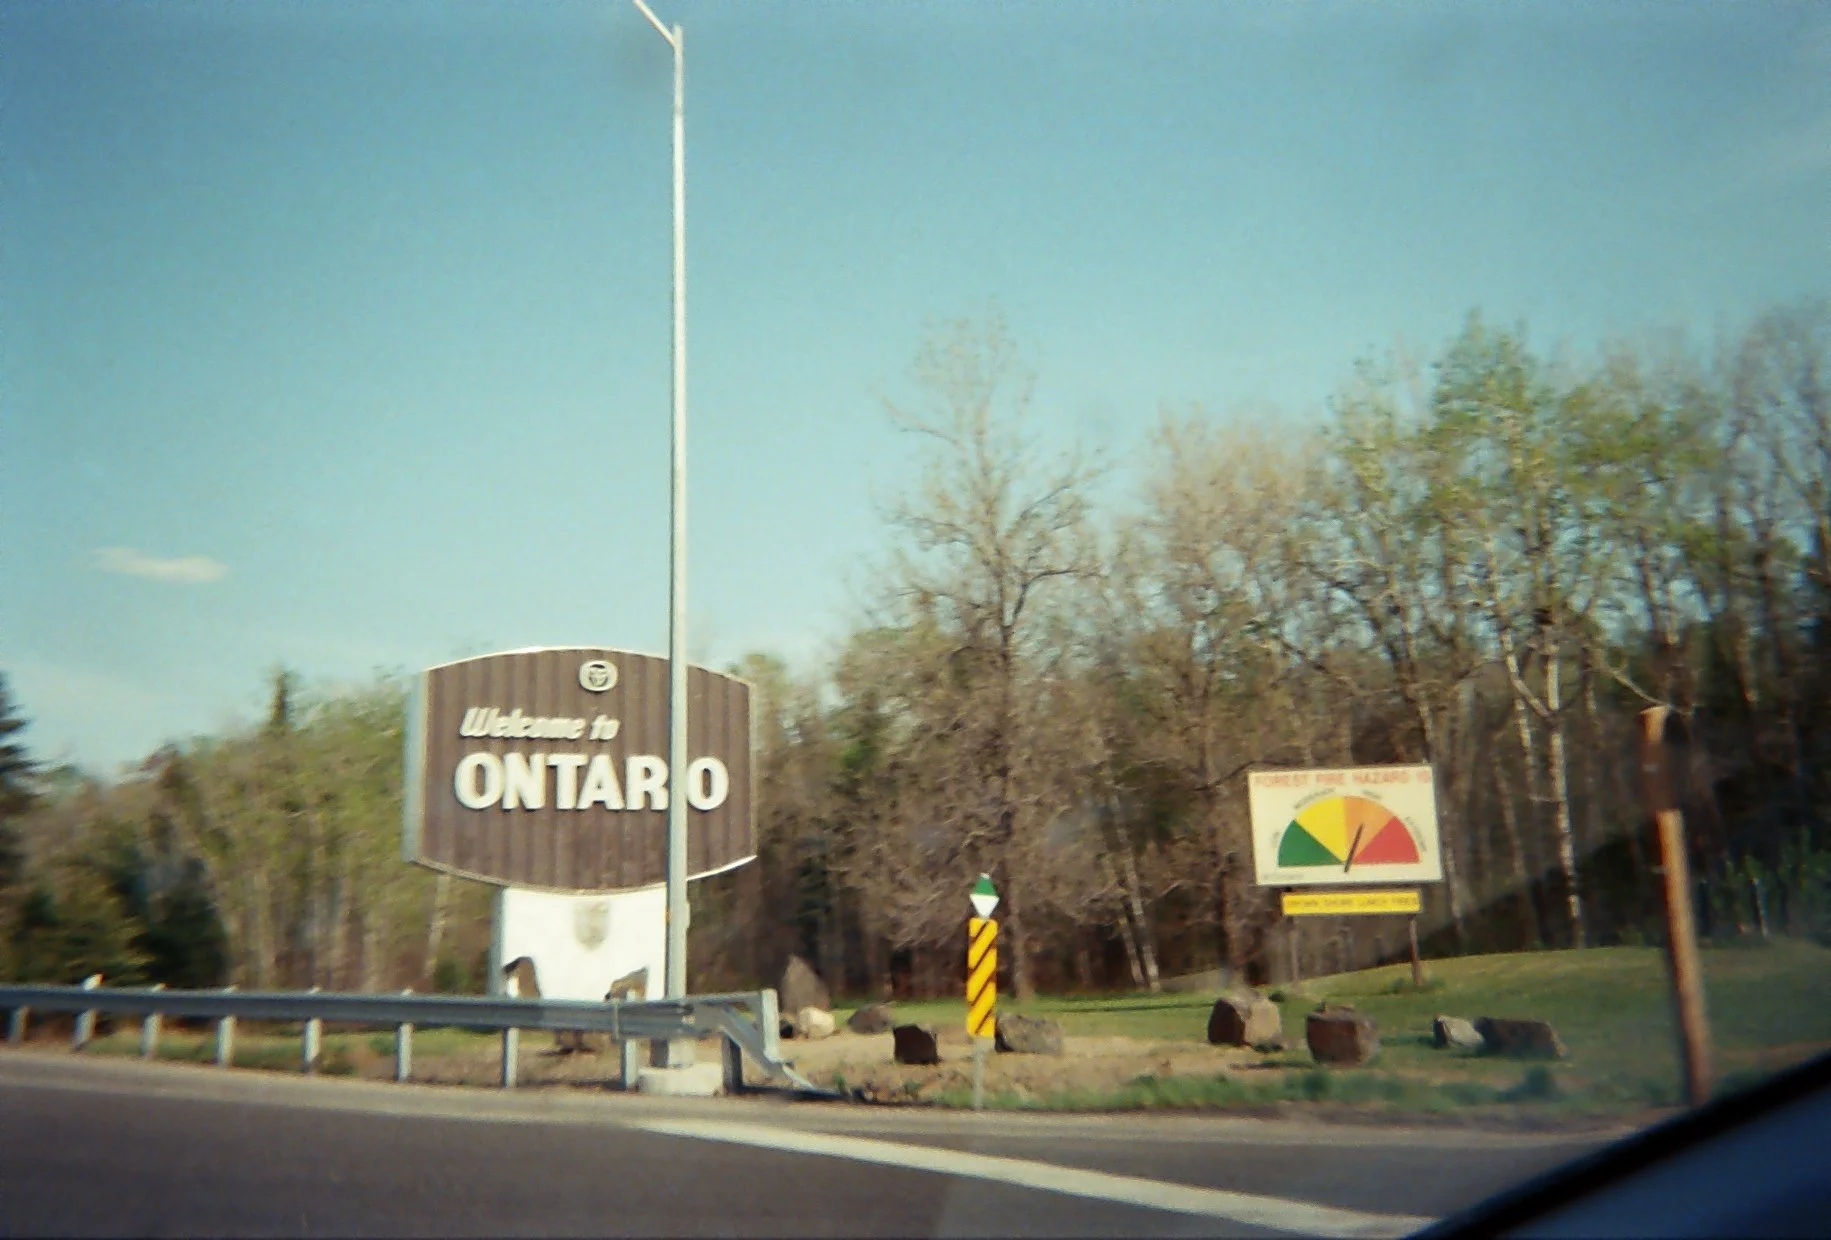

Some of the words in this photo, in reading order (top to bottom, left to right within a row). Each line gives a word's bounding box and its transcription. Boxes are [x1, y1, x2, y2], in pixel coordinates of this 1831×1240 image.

[460, 707, 586, 739] Welcome
[589, 714, 620, 740] to
[455, 752, 729, 811] ONTARO
